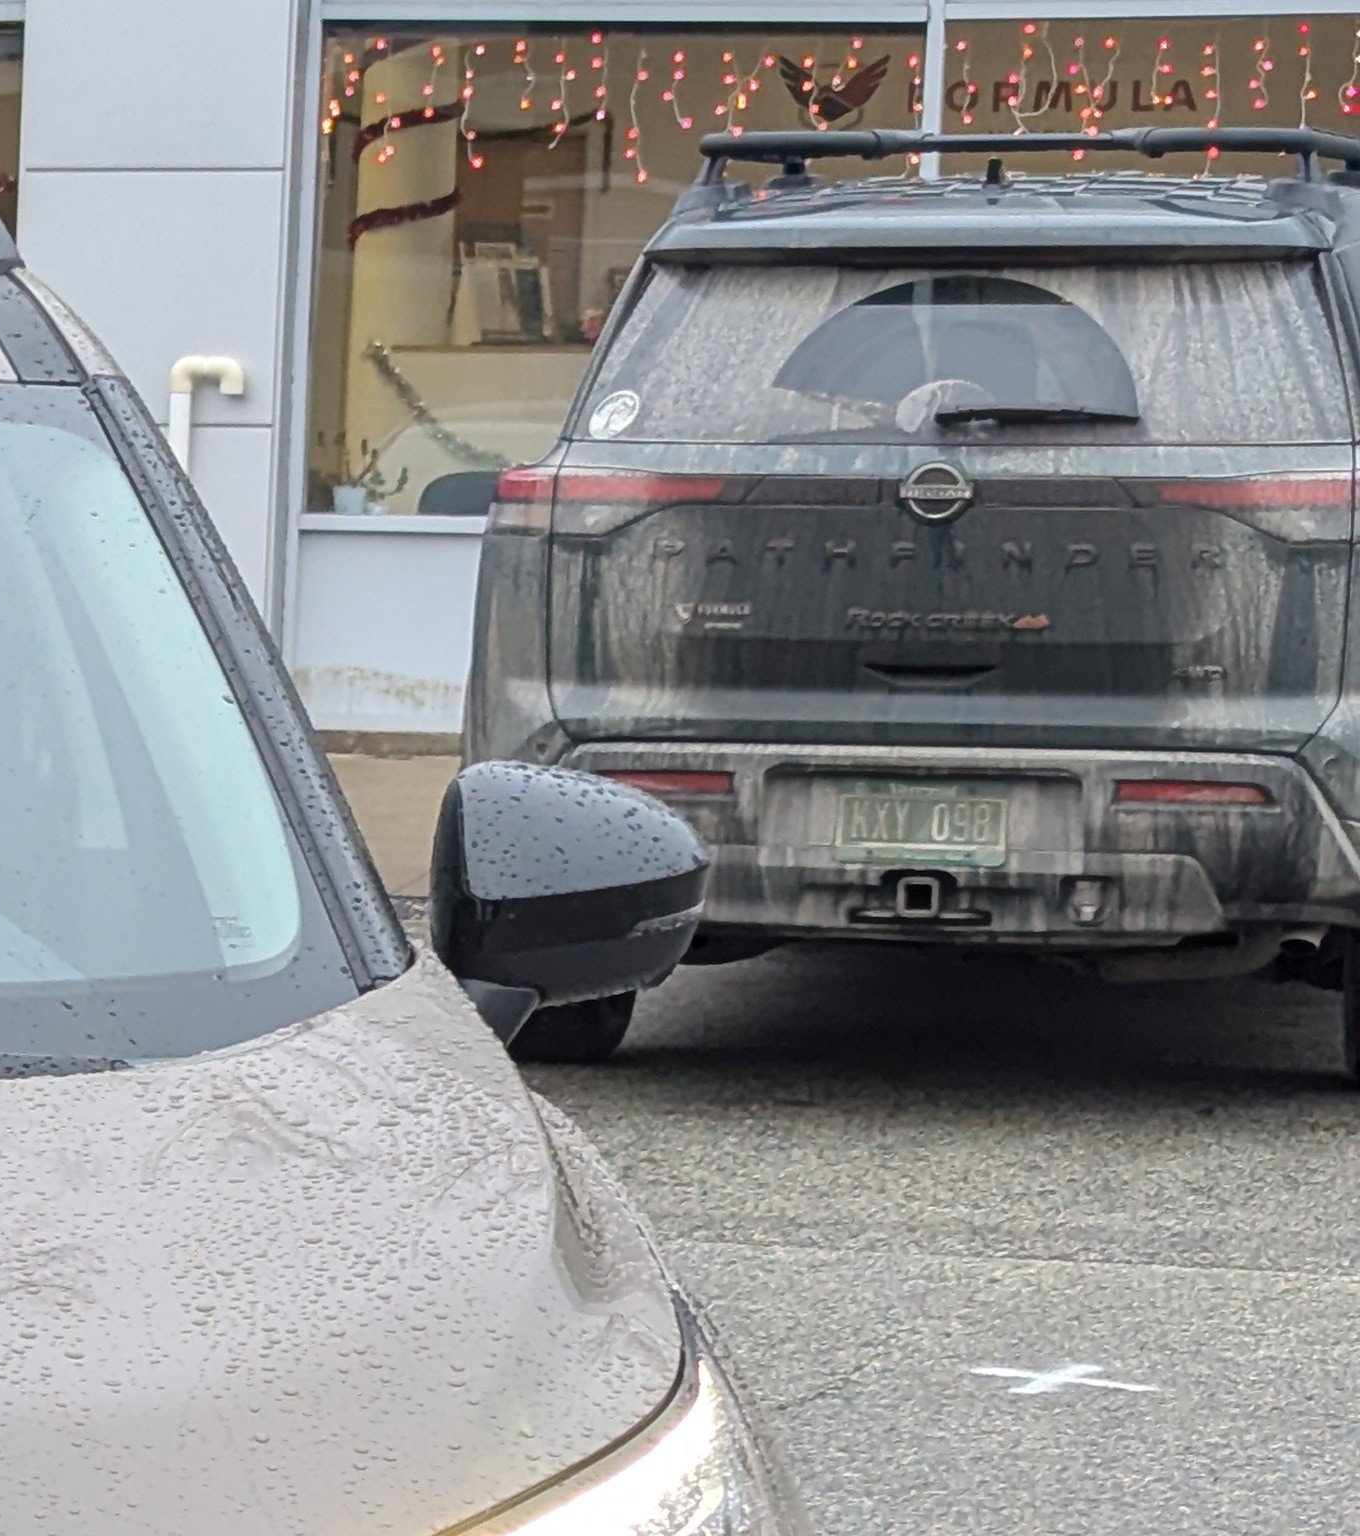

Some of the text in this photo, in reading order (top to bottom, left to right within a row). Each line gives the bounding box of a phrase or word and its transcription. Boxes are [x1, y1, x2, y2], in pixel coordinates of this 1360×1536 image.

[908, 79, 1196, 113] FORMULA
[654, 537, 1224, 570] PATHFINDER
[850, 799, 991, 842] KXY 098
